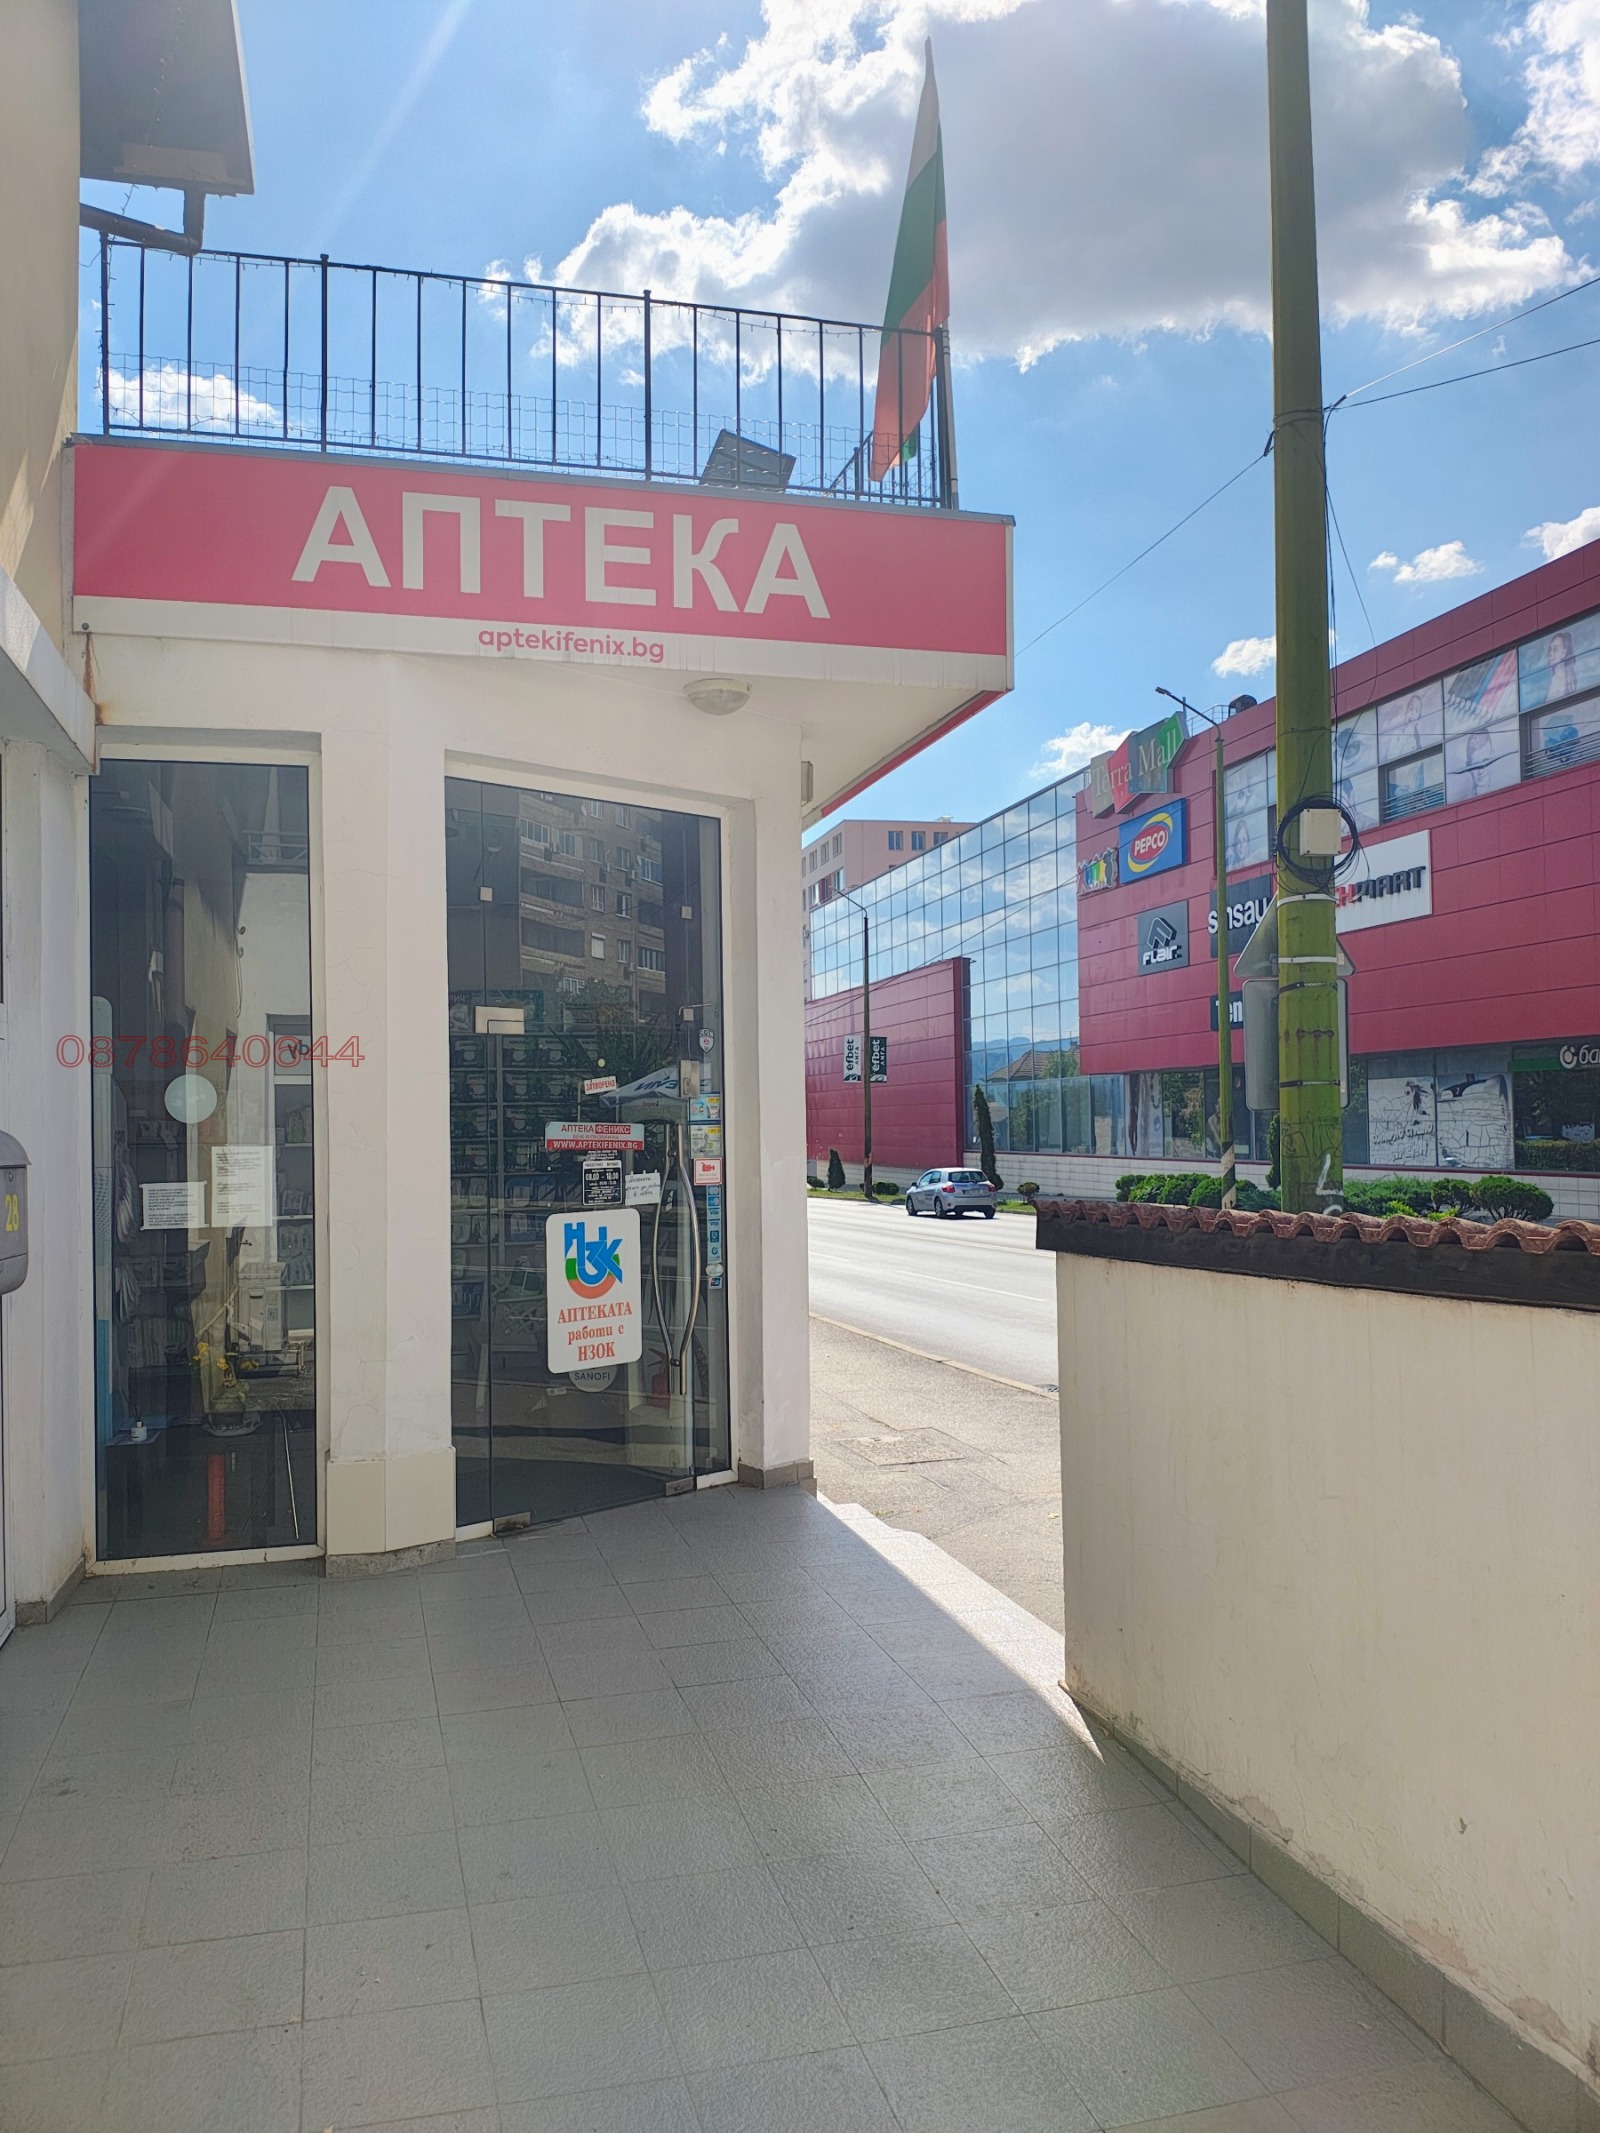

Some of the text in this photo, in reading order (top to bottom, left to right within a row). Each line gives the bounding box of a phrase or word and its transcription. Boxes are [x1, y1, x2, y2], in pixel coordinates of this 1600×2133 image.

[291, 484, 831, 619] АПТЕКА
[478, 628, 664, 663] aptekifenix.bg
[1093, 729, 1177, 797] Terra Mall
[1134, 830, 1166, 857] PEPCO
[846, 1039, 854, 1071] efbet
[872, 1039, 880, 1072] efbet
[561, 1124, 630, 1134] АПТЕКА ФЕНИКС
[553, 1140, 638, 1149] WWW.APTEKIFENIX.BG
[5, 1193, 19, 1231] 28
[557, 1301, 633, 1324] АПТЕКАТА
[568, 1323, 624, 1345] работи с
[577, 1341, 615, 1362] НЗОК
[574, 1372, 611, 1381] SANOFI
